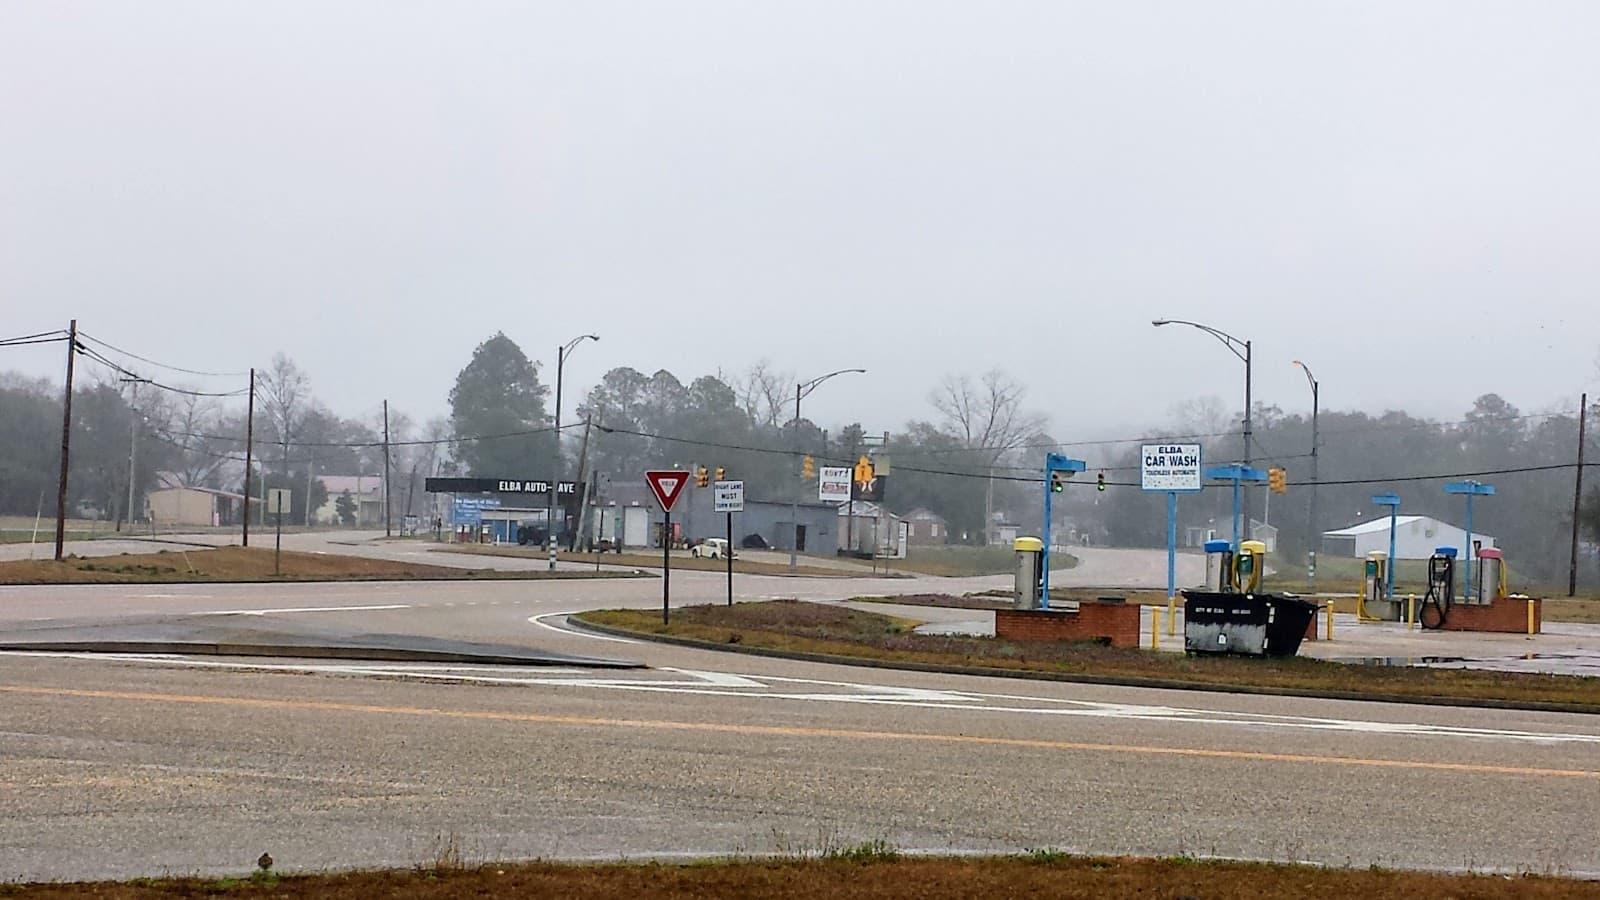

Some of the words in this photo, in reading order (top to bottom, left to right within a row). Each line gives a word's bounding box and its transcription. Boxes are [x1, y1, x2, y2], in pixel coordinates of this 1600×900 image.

[1158, 446, 1183, 454] ELBA
[1145, 455, 1165, 467] CAR
[1169, 455, 1197, 467] WASH
[499, 481, 521, 491] ELBA
[721, 492, 737, 500] MUST
